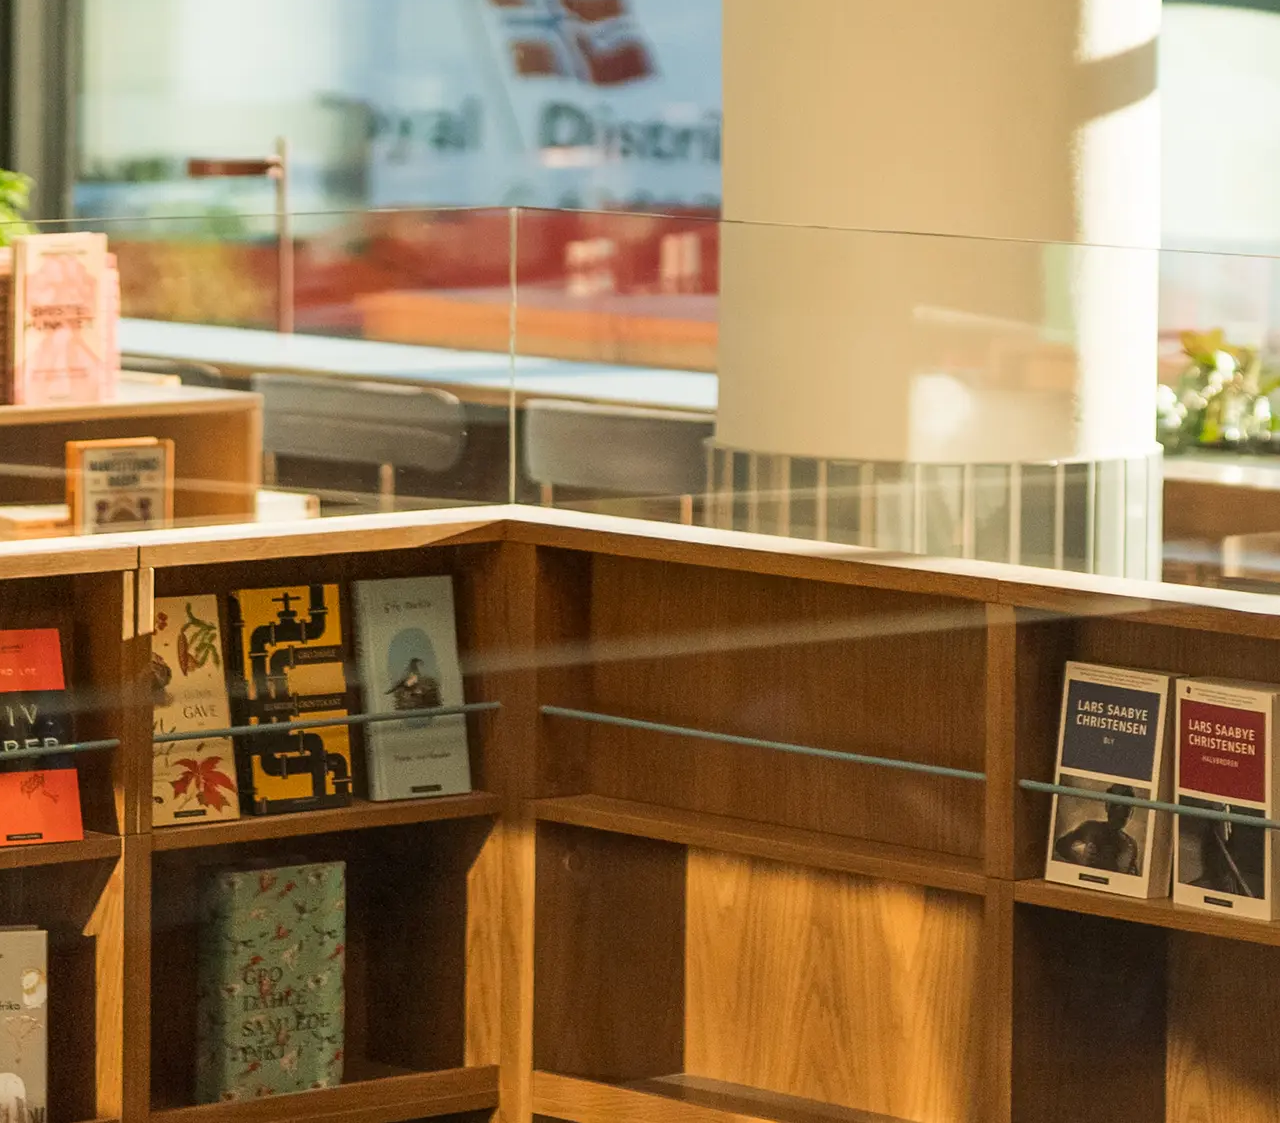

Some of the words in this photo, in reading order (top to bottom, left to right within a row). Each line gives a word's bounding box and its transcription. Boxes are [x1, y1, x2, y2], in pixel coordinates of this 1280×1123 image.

[1078, 699, 1104, 714] LARS
[1107, 704, 1149, 722] SAABYE
[1076, 714, 1147, 736] CHRISTENSEN
[1188, 719, 1212, 734] LARS
[1215, 723, 1256, 741] SAABYE
[1188, 733, 1256, 756] CHRISTENSEN
